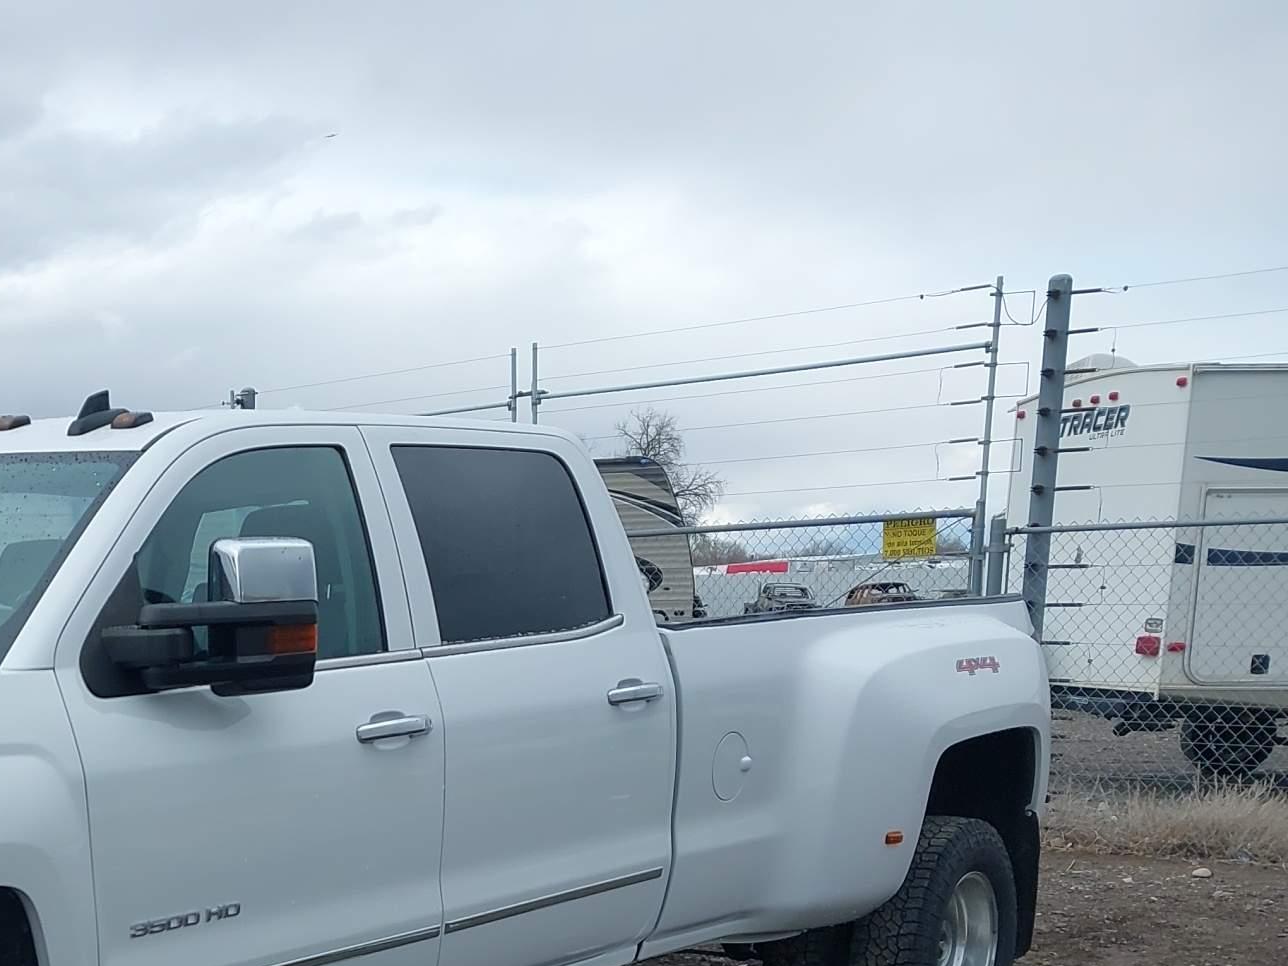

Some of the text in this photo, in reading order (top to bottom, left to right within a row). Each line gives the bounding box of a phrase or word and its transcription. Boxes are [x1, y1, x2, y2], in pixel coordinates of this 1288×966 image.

[1059, 404, 1130, 438] TRACER
[886, 518, 935, 528] PELIGRO
[904, 529, 927, 537] TOQUE
[129, 902, 241, 939] 3500 HD
